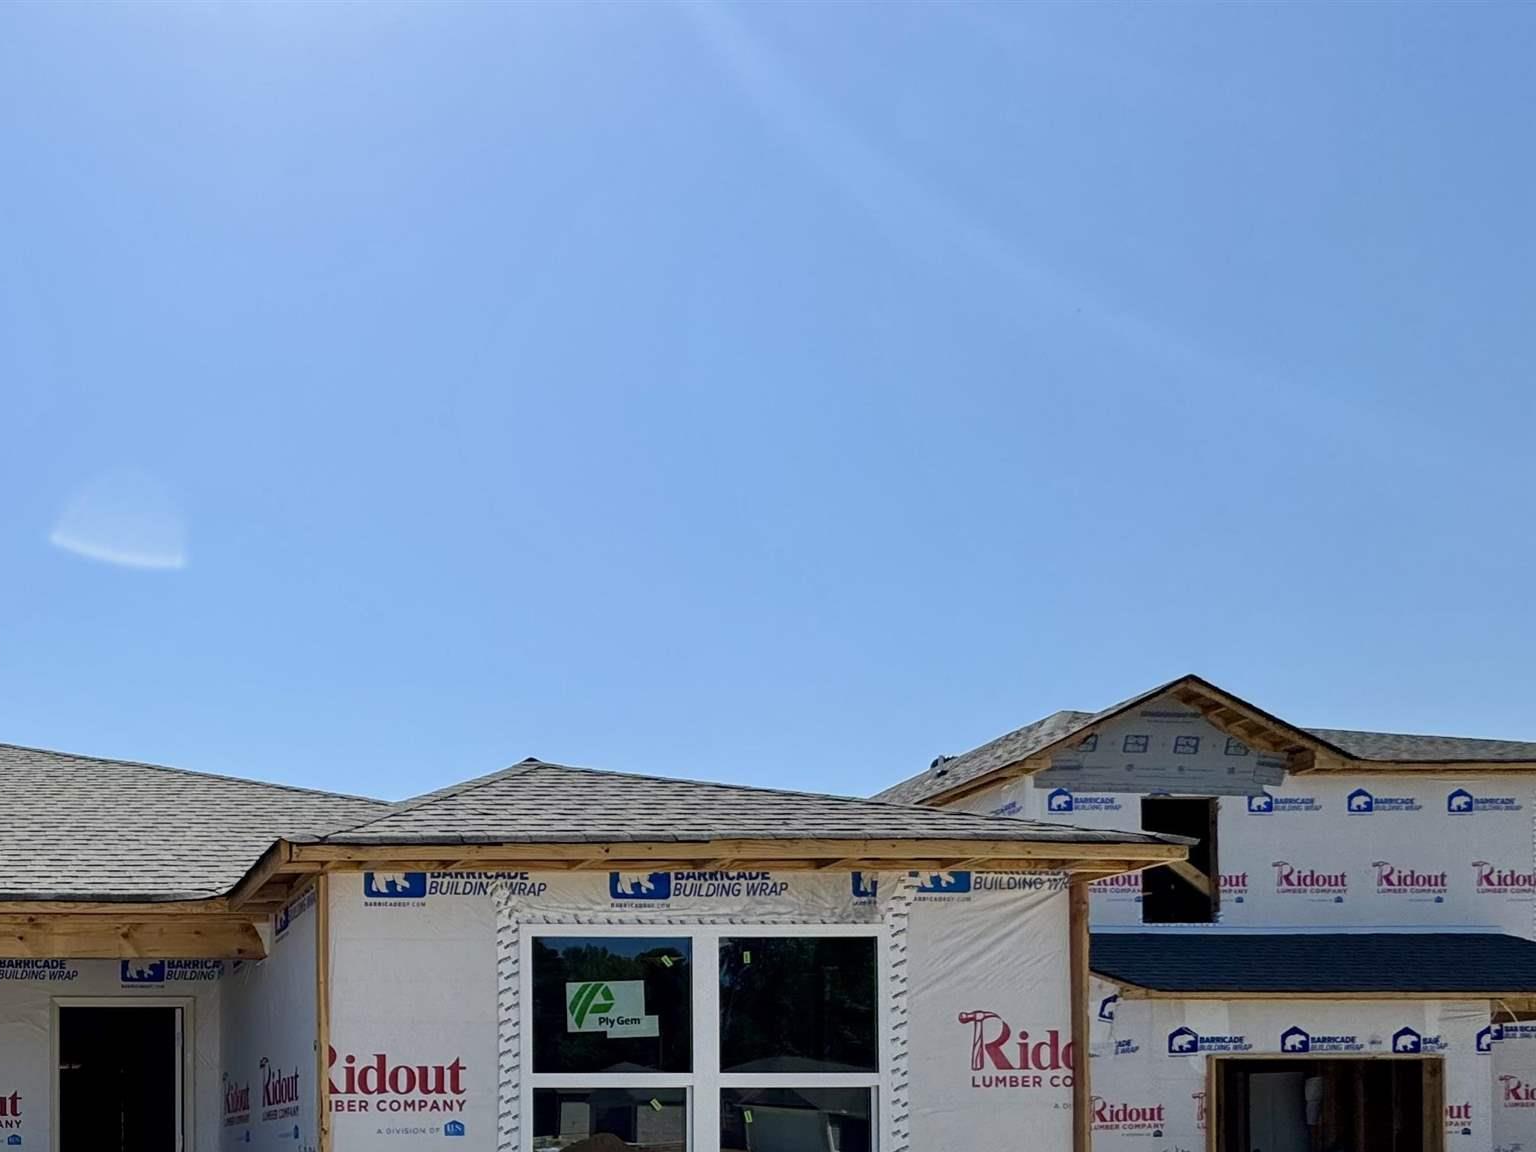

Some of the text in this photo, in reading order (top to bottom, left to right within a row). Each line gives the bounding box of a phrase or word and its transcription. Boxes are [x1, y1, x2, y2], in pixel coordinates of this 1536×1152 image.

[1272, 861, 1347, 887] Ridout
[1372, 861, 1447, 887] Ridout
[1472, 861, 1536, 887] Ridou
[429, 881, 491, 895] BUILDIN
[673, 883, 789, 897] BUILDING WRAP
[973, 876, 1042, 890] BUILDING
[48, 970, 78, 980] WRAP
[166, 970, 213, 981] BUILDING
[598, 1016, 640, 1028] Ply Gem
[958, 1010, 1074, 1071] Rid
[259, 1057, 300, 1107] Ridout
[972, 1076, 1041, 1088] LUMBER
[376, 1100, 467, 1112] COMPANY
[1090, 1096, 1165, 1122] Ridout
